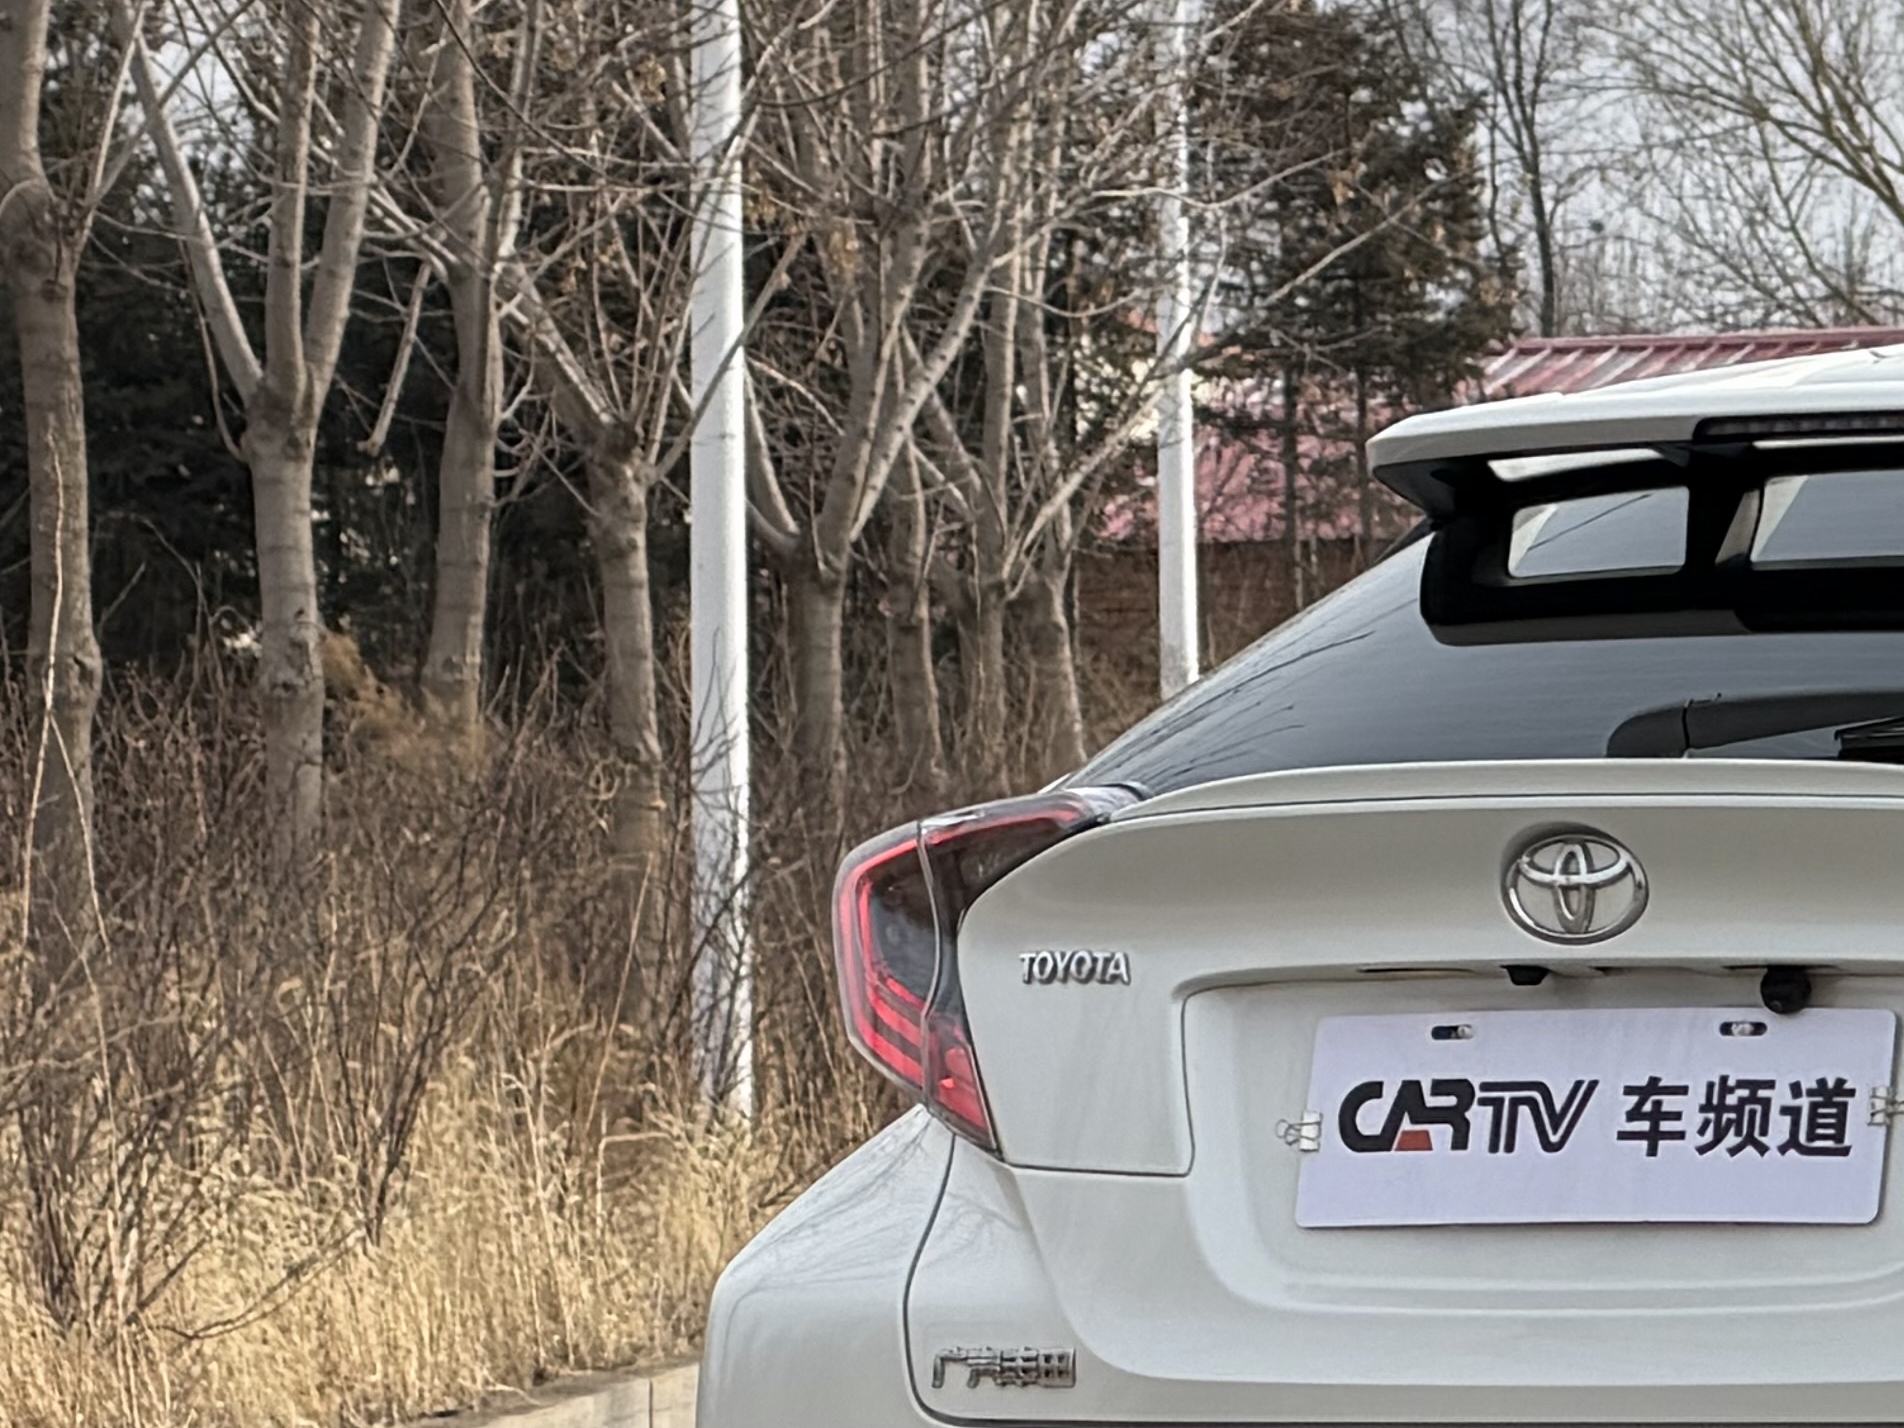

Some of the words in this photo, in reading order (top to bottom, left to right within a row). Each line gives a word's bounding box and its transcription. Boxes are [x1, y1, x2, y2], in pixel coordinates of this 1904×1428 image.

[1019, 950, 1131, 985] TOYOTA
[1338, 1078, 1600, 1154] CARTV
[1616, 1075, 1857, 1158] 车频道
